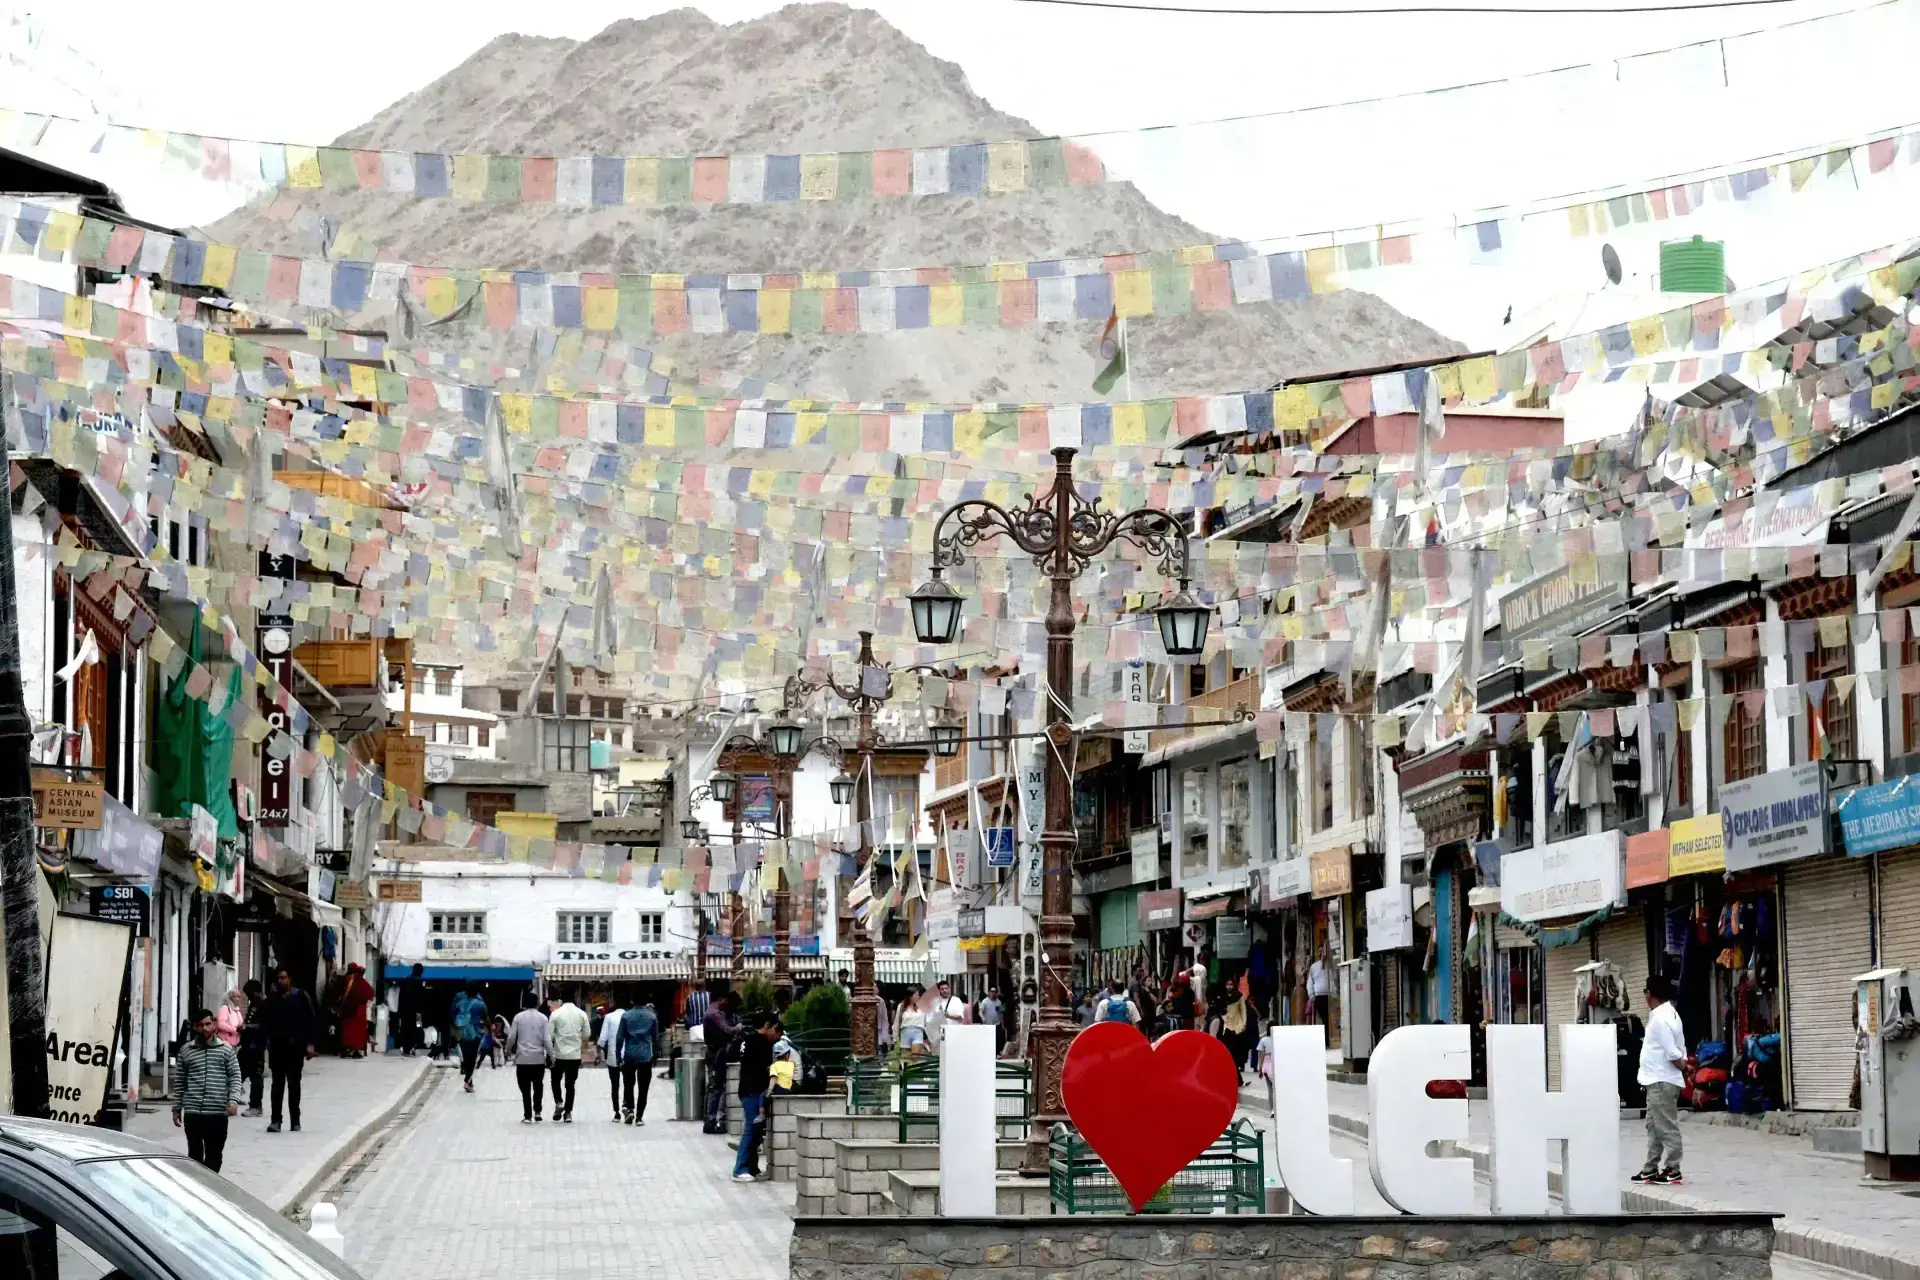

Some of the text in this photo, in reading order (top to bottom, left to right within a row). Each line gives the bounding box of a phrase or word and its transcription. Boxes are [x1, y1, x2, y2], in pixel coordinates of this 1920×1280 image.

[267, 658, 285, 799] Tael
[49, 788, 97, 798] CENTRAL
[48, 798, 82, 807] ASIAN
[1770, 792, 1820, 828] HIMALAYAS
[48, 808, 95, 817] MUSEUM
[261, 808, 289, 820] 24x7
[1841, 820, 1862, 840] THE
[1862, 808, 1909, 837] MERIDIAN
[1694, 834, 1722, 853] SELECTED
[114, 887, 134, 899] SBI
[557, 950, 675, 960] The Gift
[46, 1032, 109, 1068] Area
[939, 1023, 1621, 1217] I LEH
